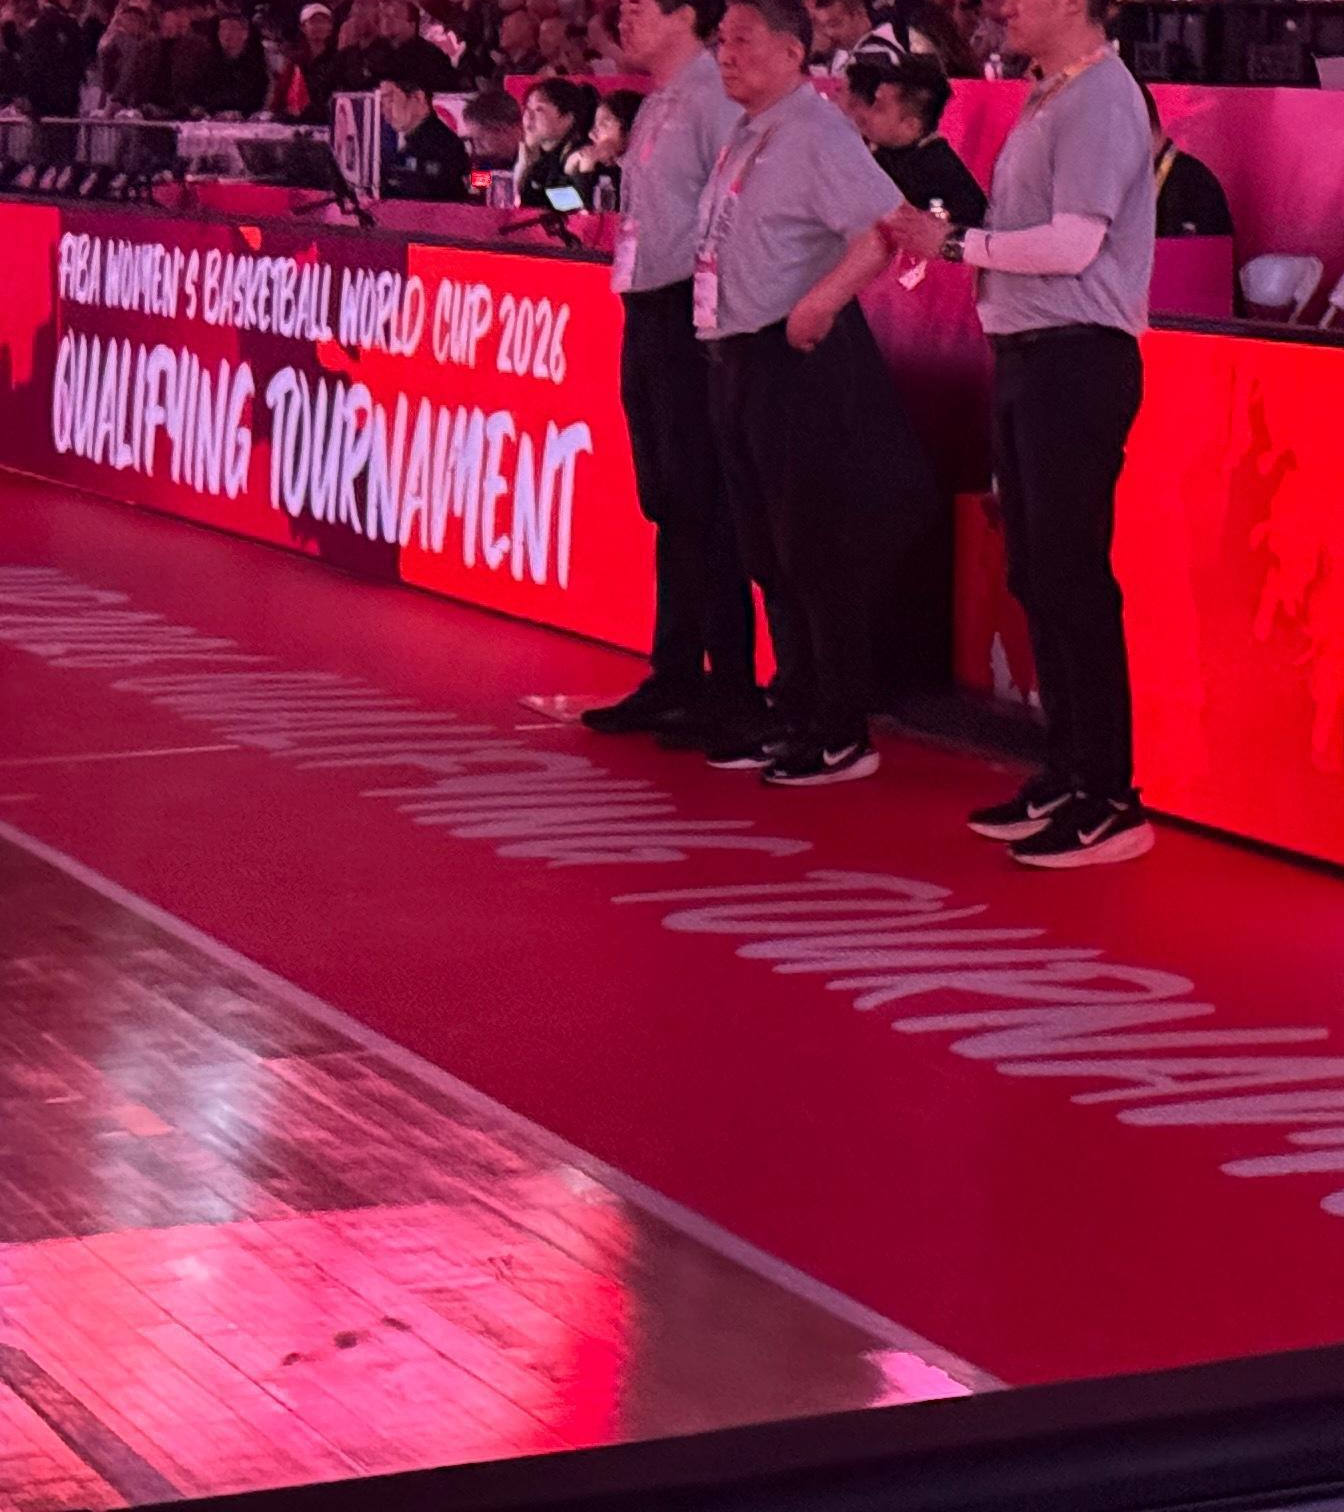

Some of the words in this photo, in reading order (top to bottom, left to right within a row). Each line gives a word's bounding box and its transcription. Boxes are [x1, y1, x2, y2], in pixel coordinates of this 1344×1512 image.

[59, 231, 102, 306] FIBA
[104, 239, 199, 320] WOMEN'S
[201, 248, 332, 342] BASKETBALL
[339, 267, 426, 358] WORLD
[432, 276, 494, 369] CUP
[497, 292, 570, 385] 2026
[54, 329, 256, 500] QUALIFYING
[267, 365, 594, 588] TOURNAMENT
